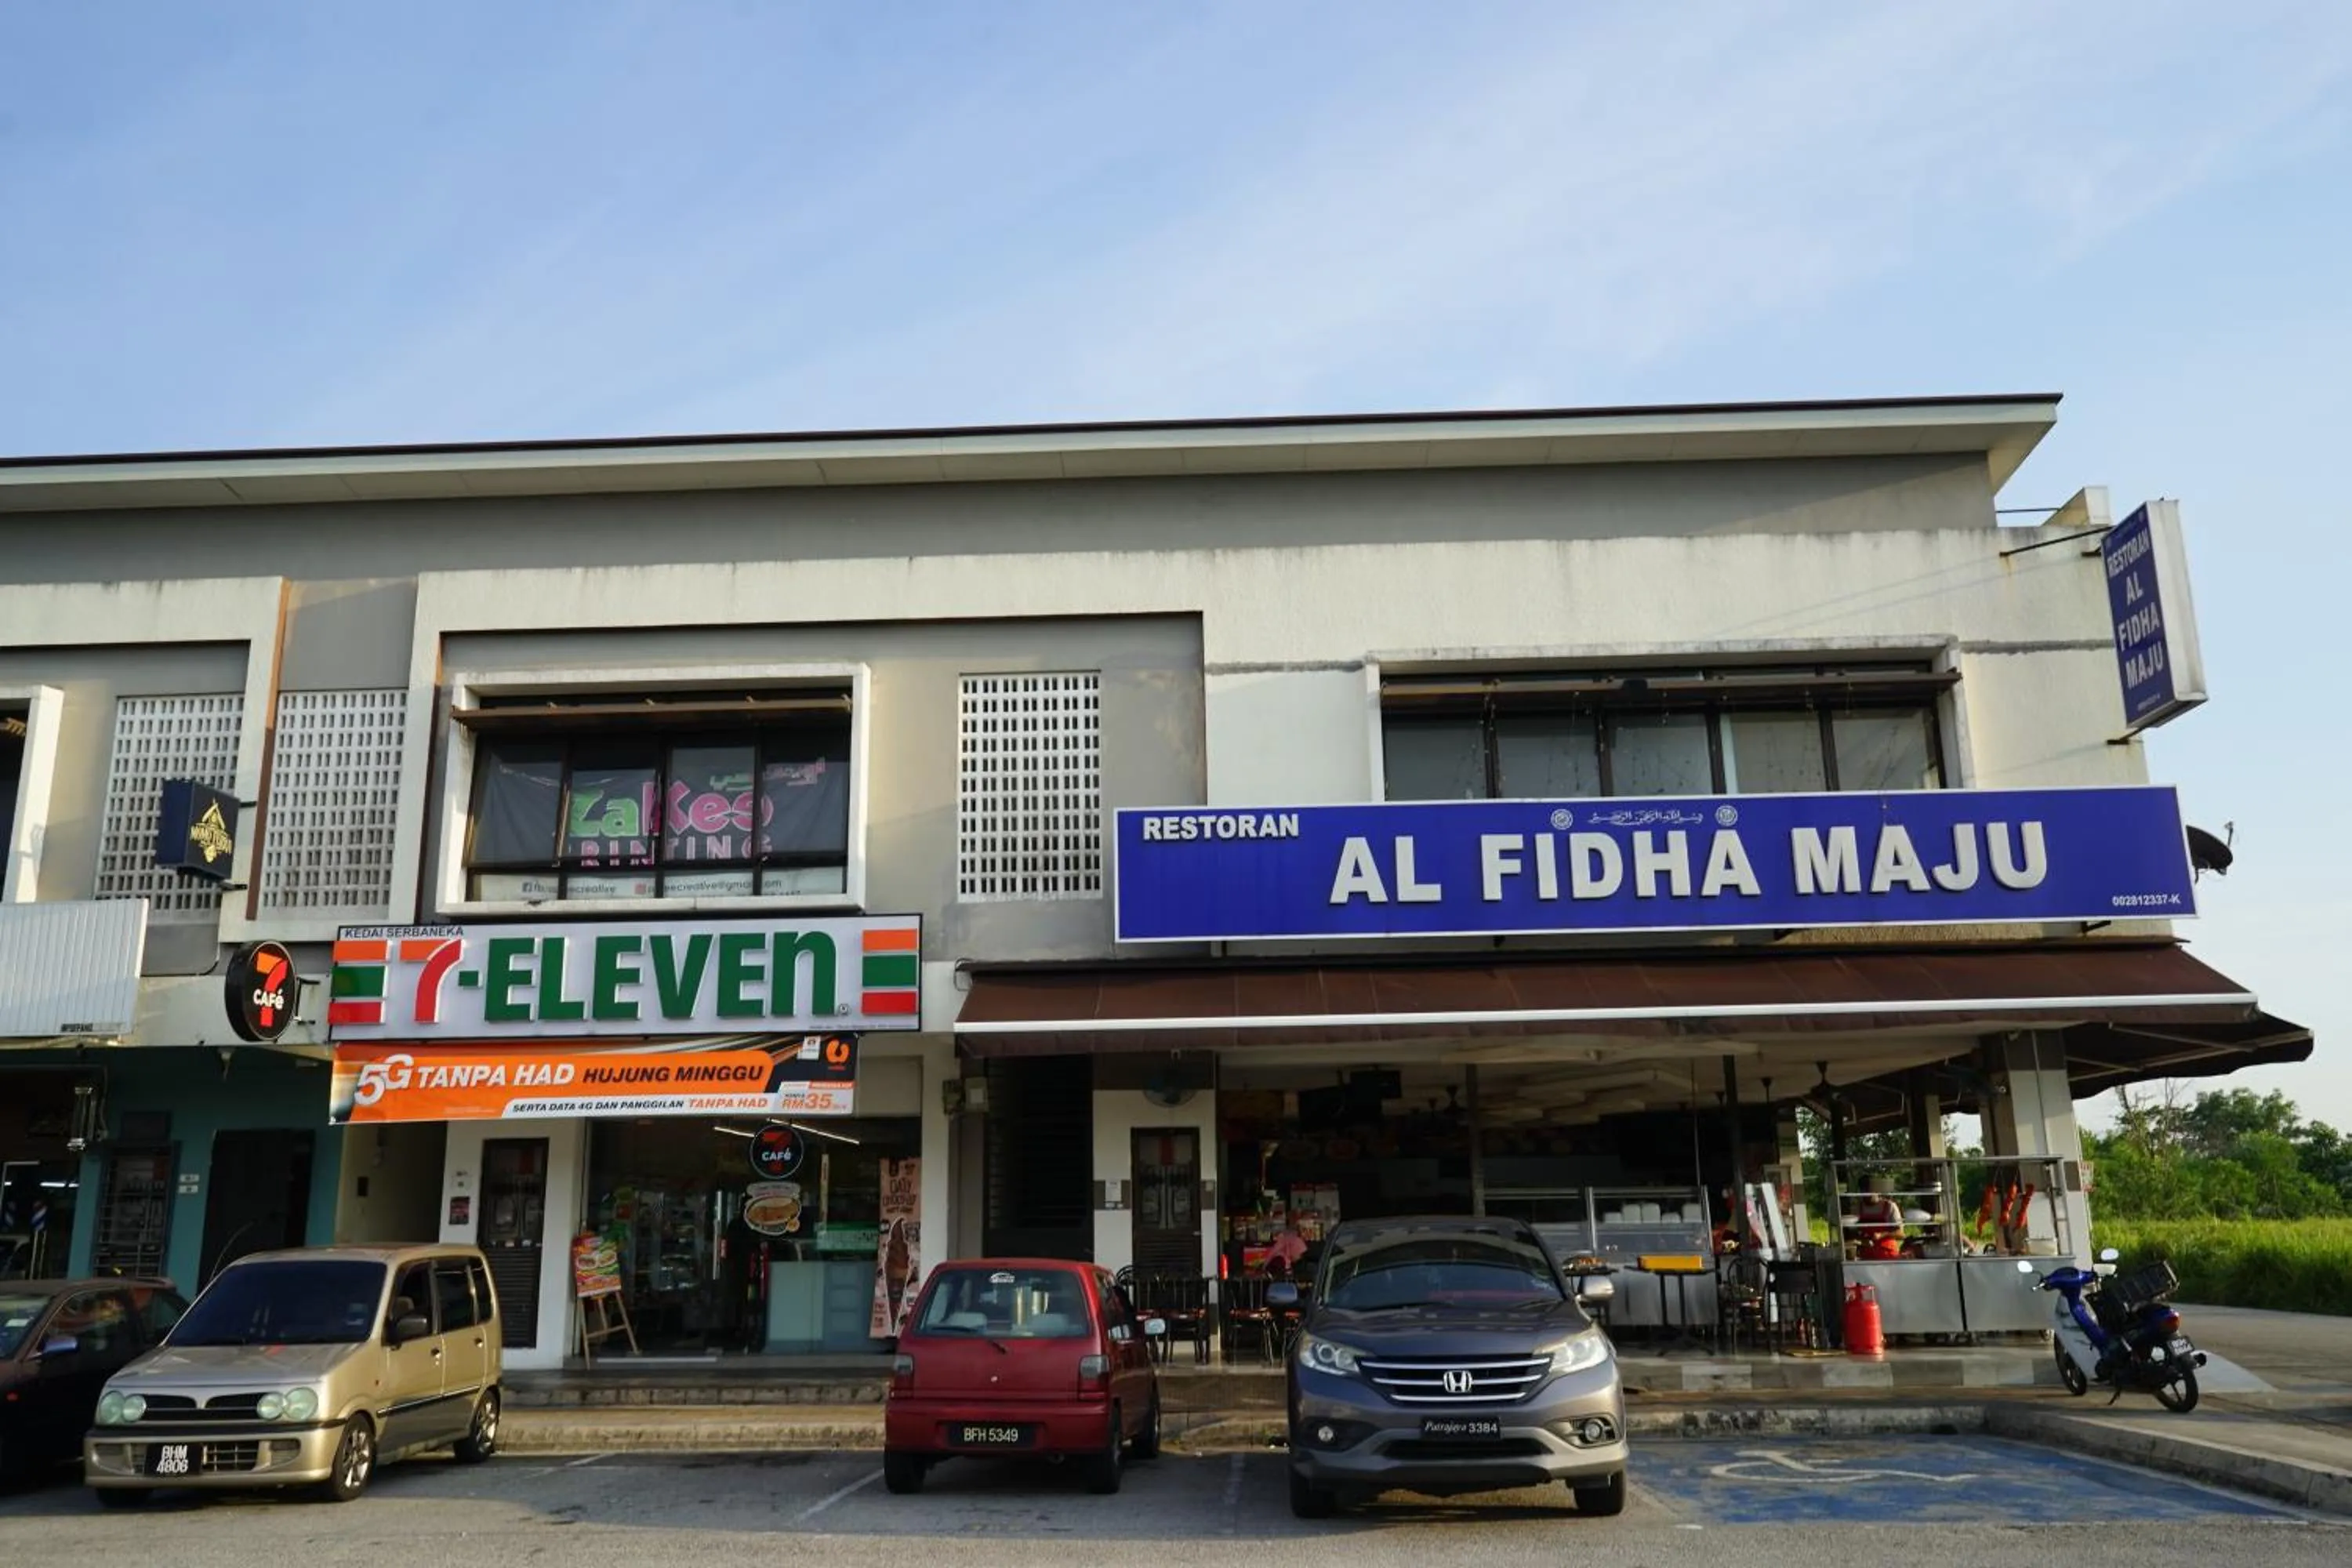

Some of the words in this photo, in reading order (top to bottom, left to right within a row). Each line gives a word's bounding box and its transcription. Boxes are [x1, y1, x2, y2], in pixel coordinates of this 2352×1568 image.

[2107, 528, 2150, 578] RESTORAN
[2125, 571, 2143, 605] AL
[2117, 602, 2160, 651] FIDHA
[2125, 641, 2164, 689] MAJU
[1142, 813, 1299, 840] RESTORAN
[1329, 835, 1442, 904] AL
[1479, 828, 1762, 901] FIDHA
[1790, 821, 2049, 895] MAJU
[2112, 894, 2181, 907] 002812337-K
[344, 927, 384, 938] KEDAI
[387, 924, 464, 937] SERBANEKA
[354, 1054, 415, 1105] 5G
[416, 1065, 506, 1089] TANPA
[514, 1063, 575, 1087] HAD
[582, 1066, 670, 1085] HUJUNG
[673, 1062, 764, 1083] MINGGU
[512, 1103, 547, 1113] SERTA
[549, 1102, 576, 1112] DATA
[578, 1102, 593, 1111] 4G
[595, 1102, 619, 1110] DAN
[620, 1099, 684, 1110] PANGGILAN
[688, 1098, 735, 1109] TANPA
[738, 1097, 768, 1108] HAD
[964, 1427, 987, 1443] BFH
[989, 1428, 1018, 1443] 5349
[1468, 1421, 1498, 1435] 3384
[162, 1444, 187, 1459] BHM
